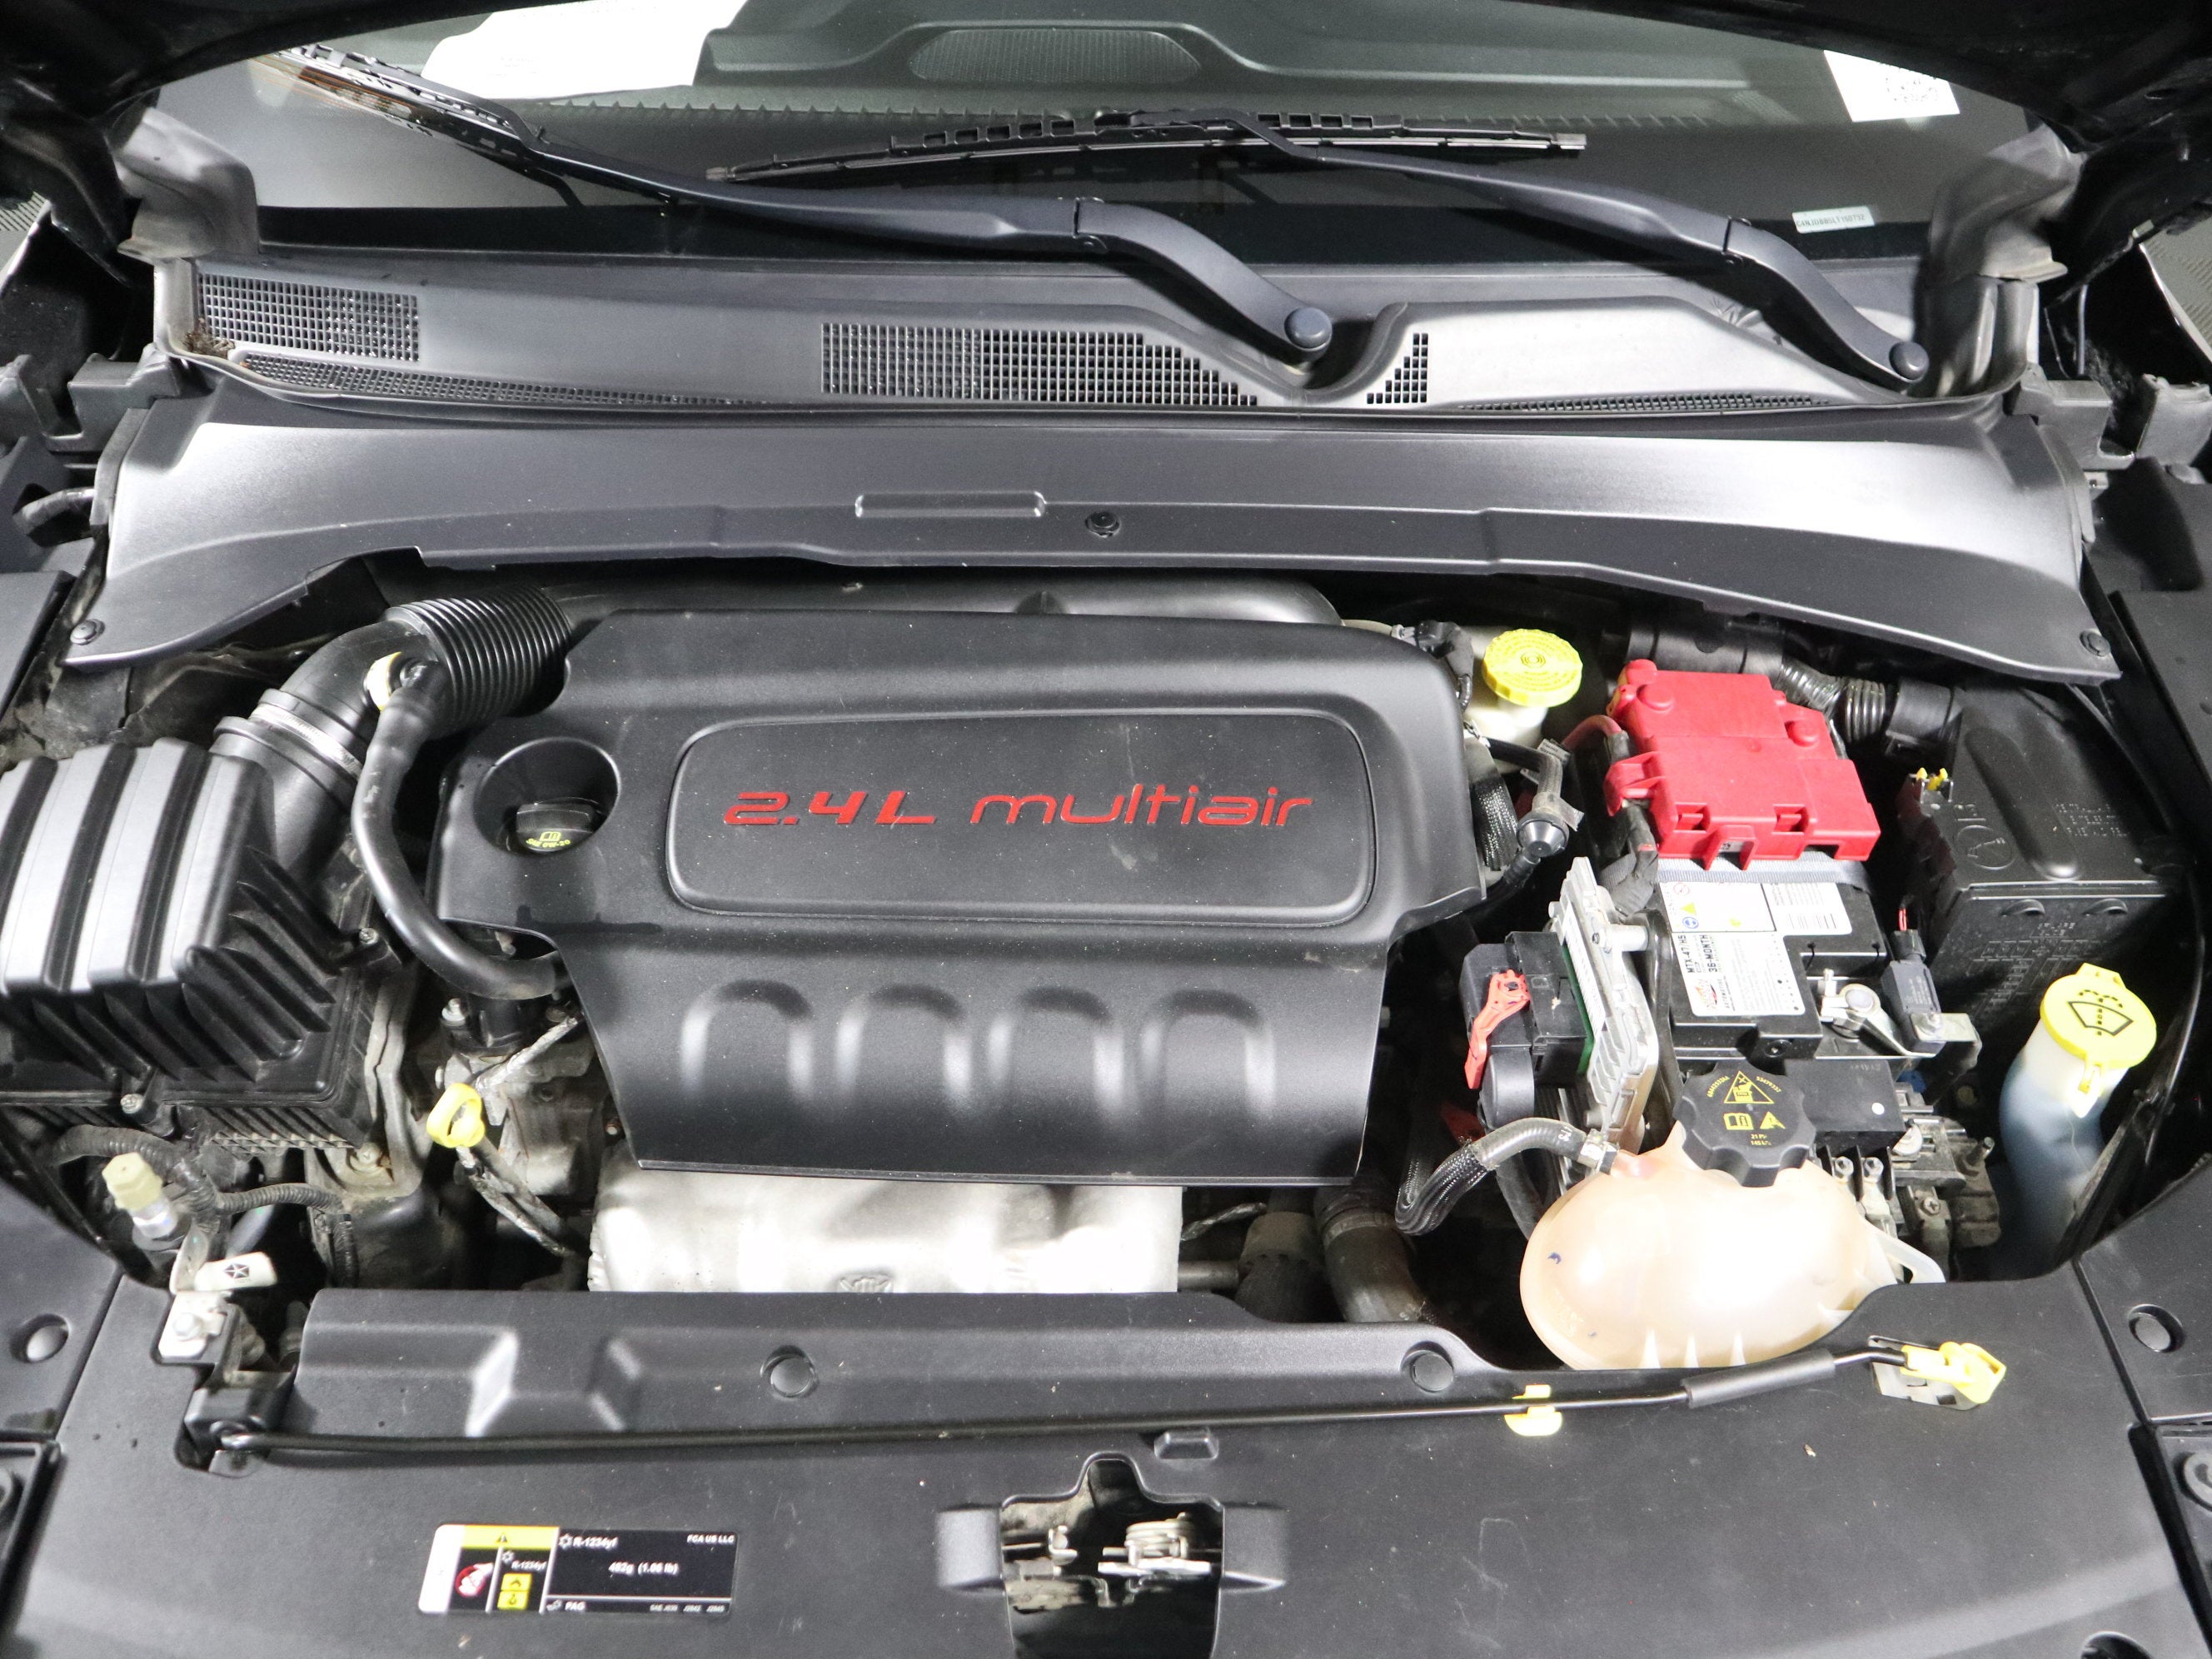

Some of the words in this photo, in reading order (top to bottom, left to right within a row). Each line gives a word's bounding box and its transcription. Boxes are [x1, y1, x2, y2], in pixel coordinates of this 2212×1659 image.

[970, 785, 1313, 827] multiair
[526, 838, 542, 847] SAE
[542, 839, 570, 848] 0W-20
[1699, 934, 1718, 973] 36-MONTH
[573, 1537, 619, 1550] R-1234yf
[687, 1534, 705, 1543] FCA
[705, 1535, 717, 1543] US
[718, 1535, 735, 1544] LLC
[511, 1560, 547, 1572] R-1234yf
[565, 1601, 585, 1612] PAG
